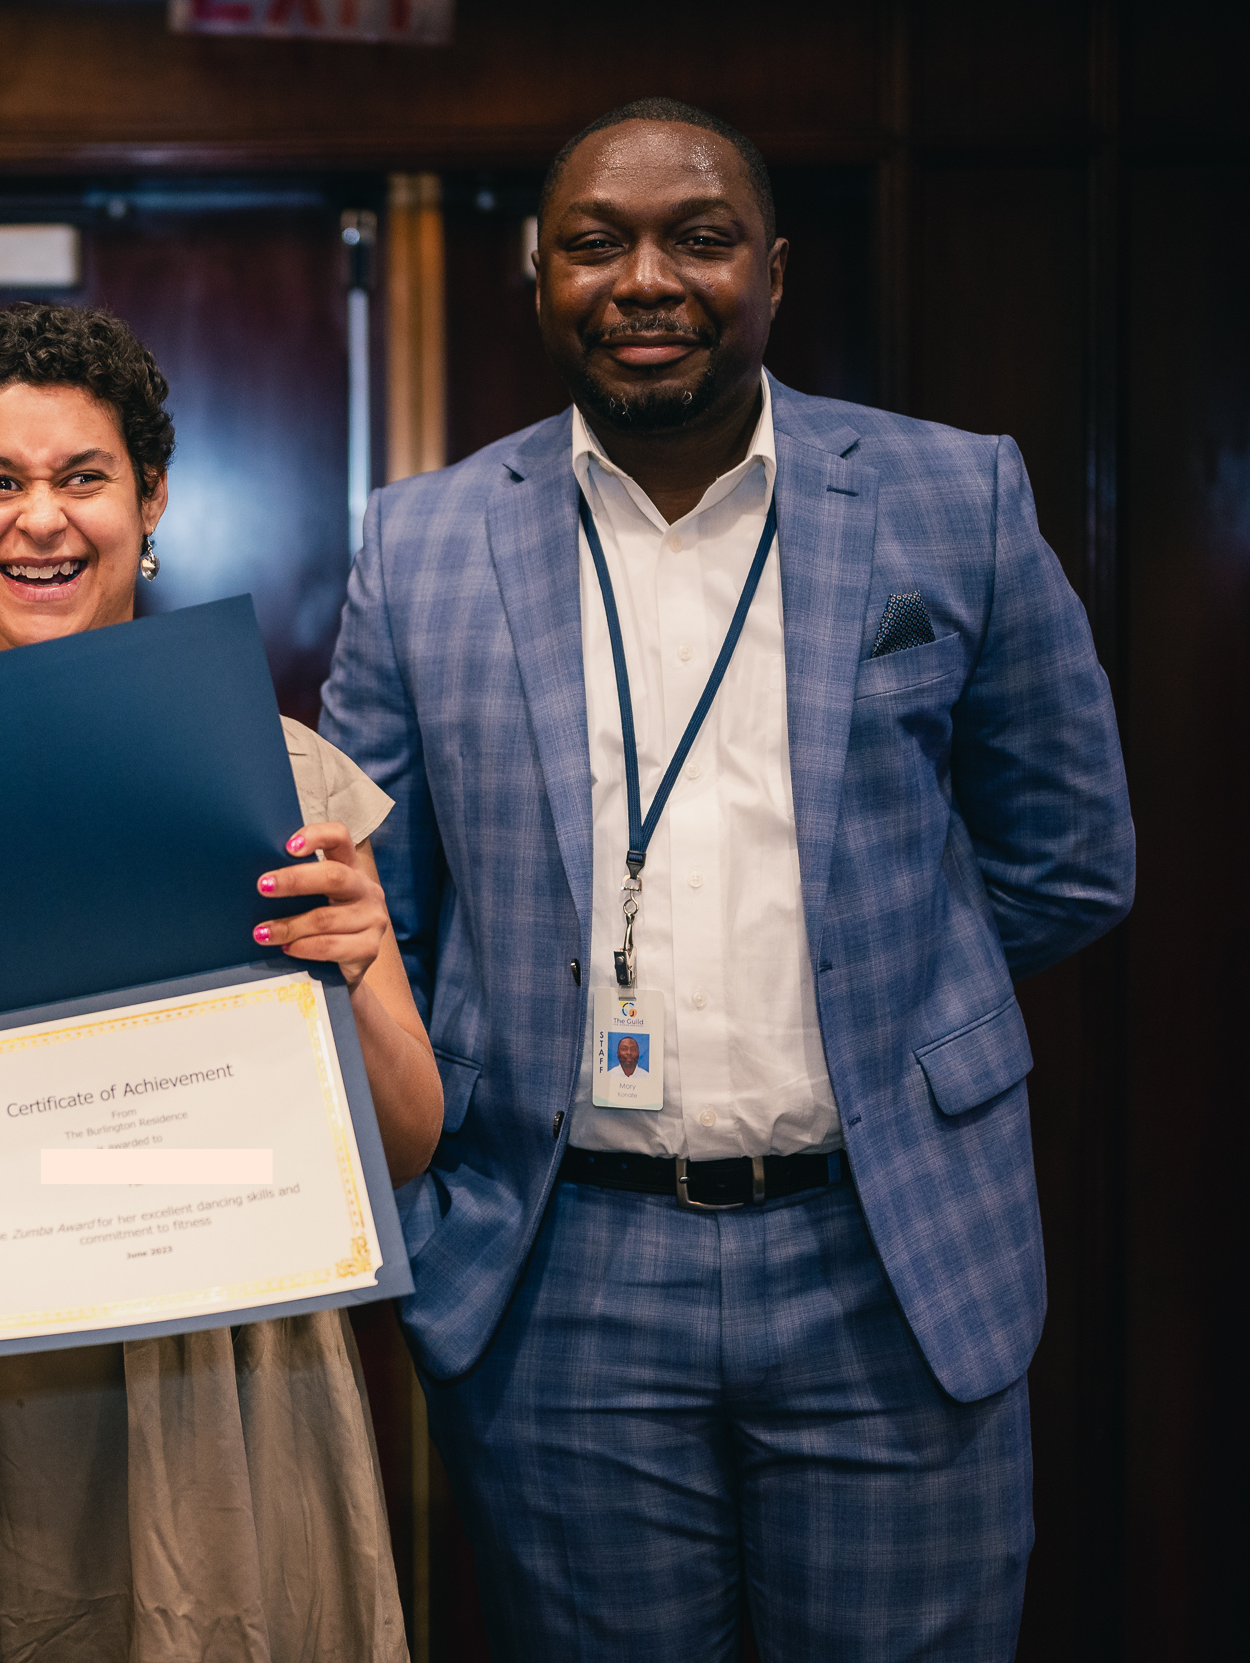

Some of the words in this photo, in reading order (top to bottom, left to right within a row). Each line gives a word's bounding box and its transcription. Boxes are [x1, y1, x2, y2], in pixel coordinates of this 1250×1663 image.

[6, 1091, 95, 1118] Certificate
[100, 1084, 117, 1102] of
[123, 1063, 234, 1097] Achievement
[64, 1130, 84, 1140] The
[87, 1121, 136, 1136] Burlington
[139, 1111, 188, 1126] Residence
[111, 1108, 137, 1119] From
[152, 1135, 163, 1143] to
[12, 1225, 53, 1241] Zumba
[57, 1219, 96, 1235] Award
[96, 1216, 114, 1228] for
[117, 1213, 136, 1225] her
[141, 1203, 192, 1222] excellent
[197, 1194, 243, 1212] dancing
[246, 1188, 275, 1202] skills
[279, 1183, 301, 1197] and
[80, 1226, 153, 1246] commitment
[157, 1221, 170, 1233] to
[173, 1216, 212, 1231] fitness
[126, 1249, 148, 1260] June
